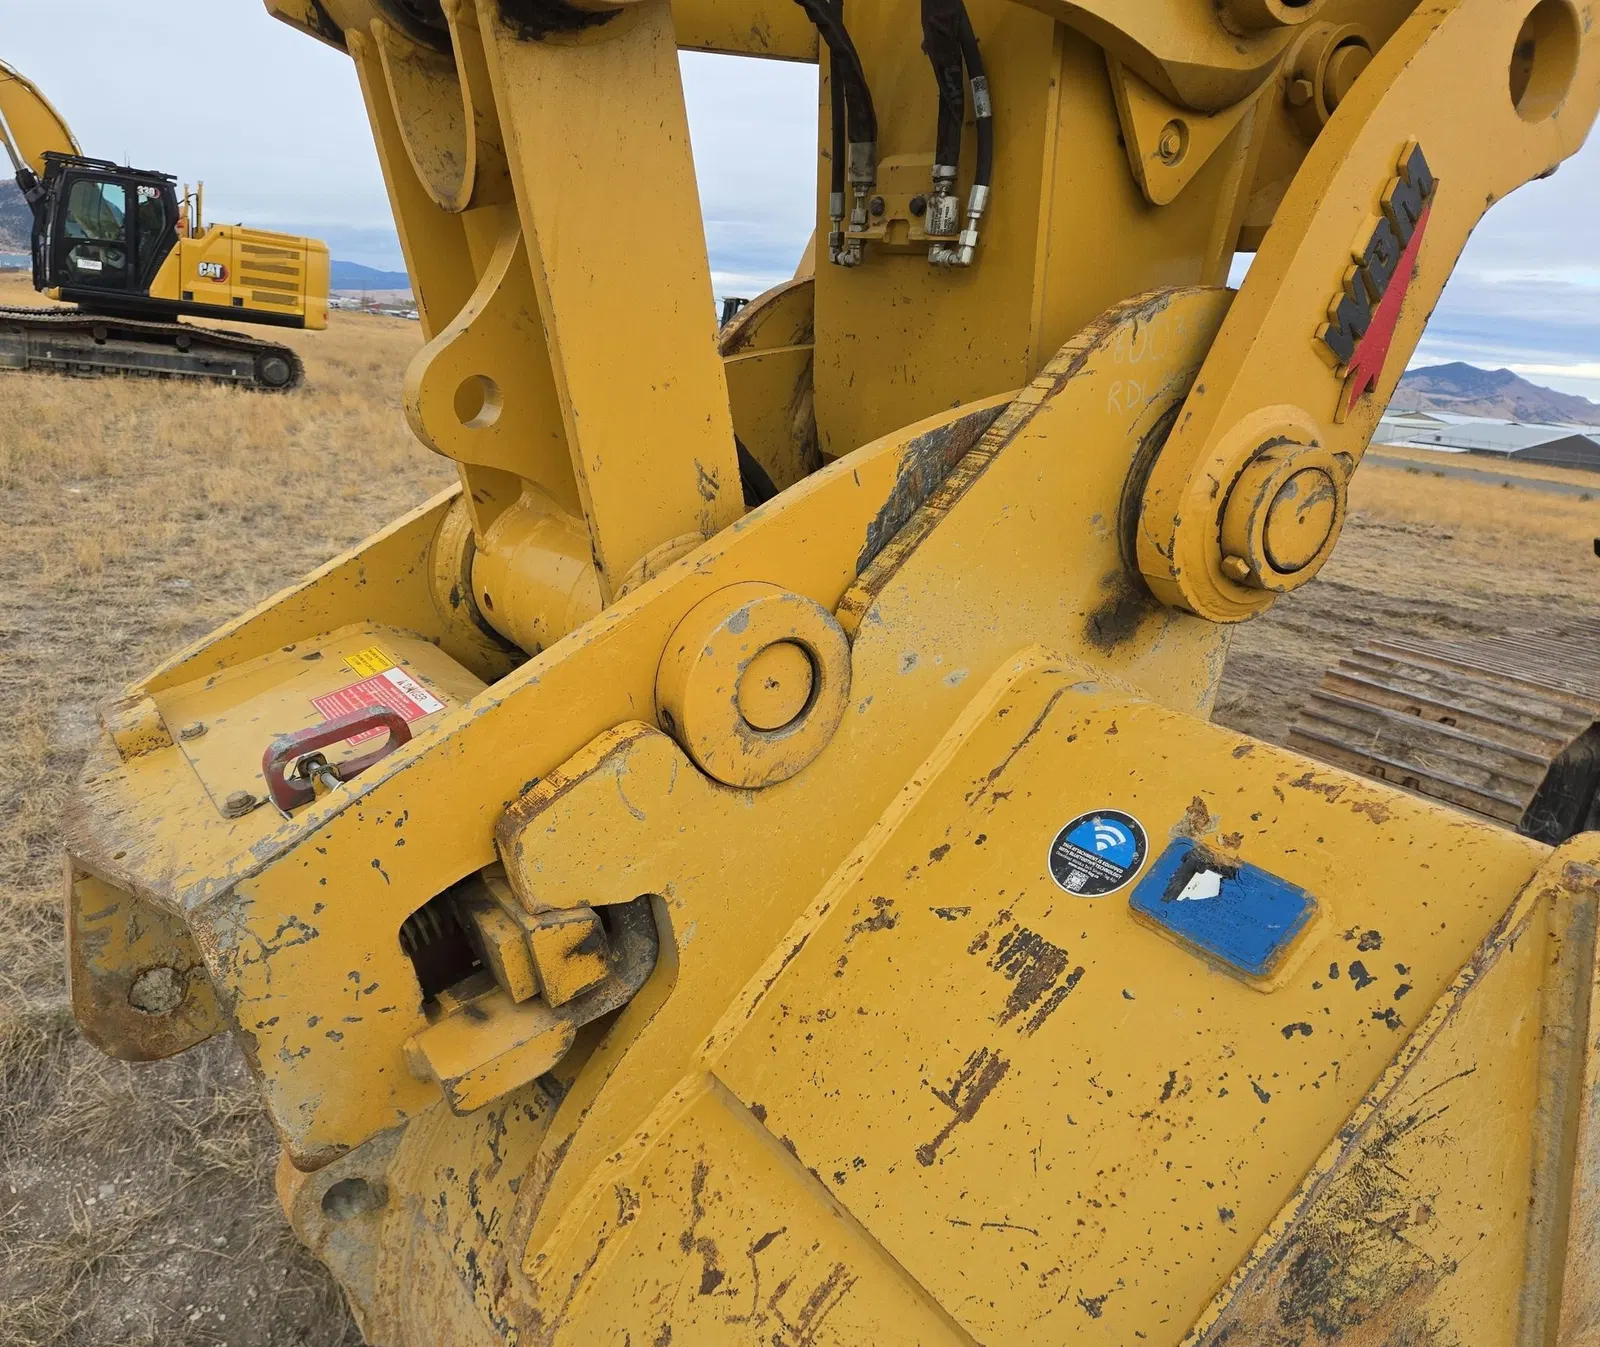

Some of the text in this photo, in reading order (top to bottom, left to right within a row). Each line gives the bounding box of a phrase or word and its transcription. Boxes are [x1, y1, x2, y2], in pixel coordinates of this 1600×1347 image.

[137, 185, 155, 198] 330
[1312, 138, 1434, 365] WBM
[198, 262, 222, 278] CAT
[1071, 846, 1098, 862] ATTACHMENT
[1102, 861, 1123, 874] EQUIPPED
[1095, 863, 1122, 879] TECHNOLOGY
